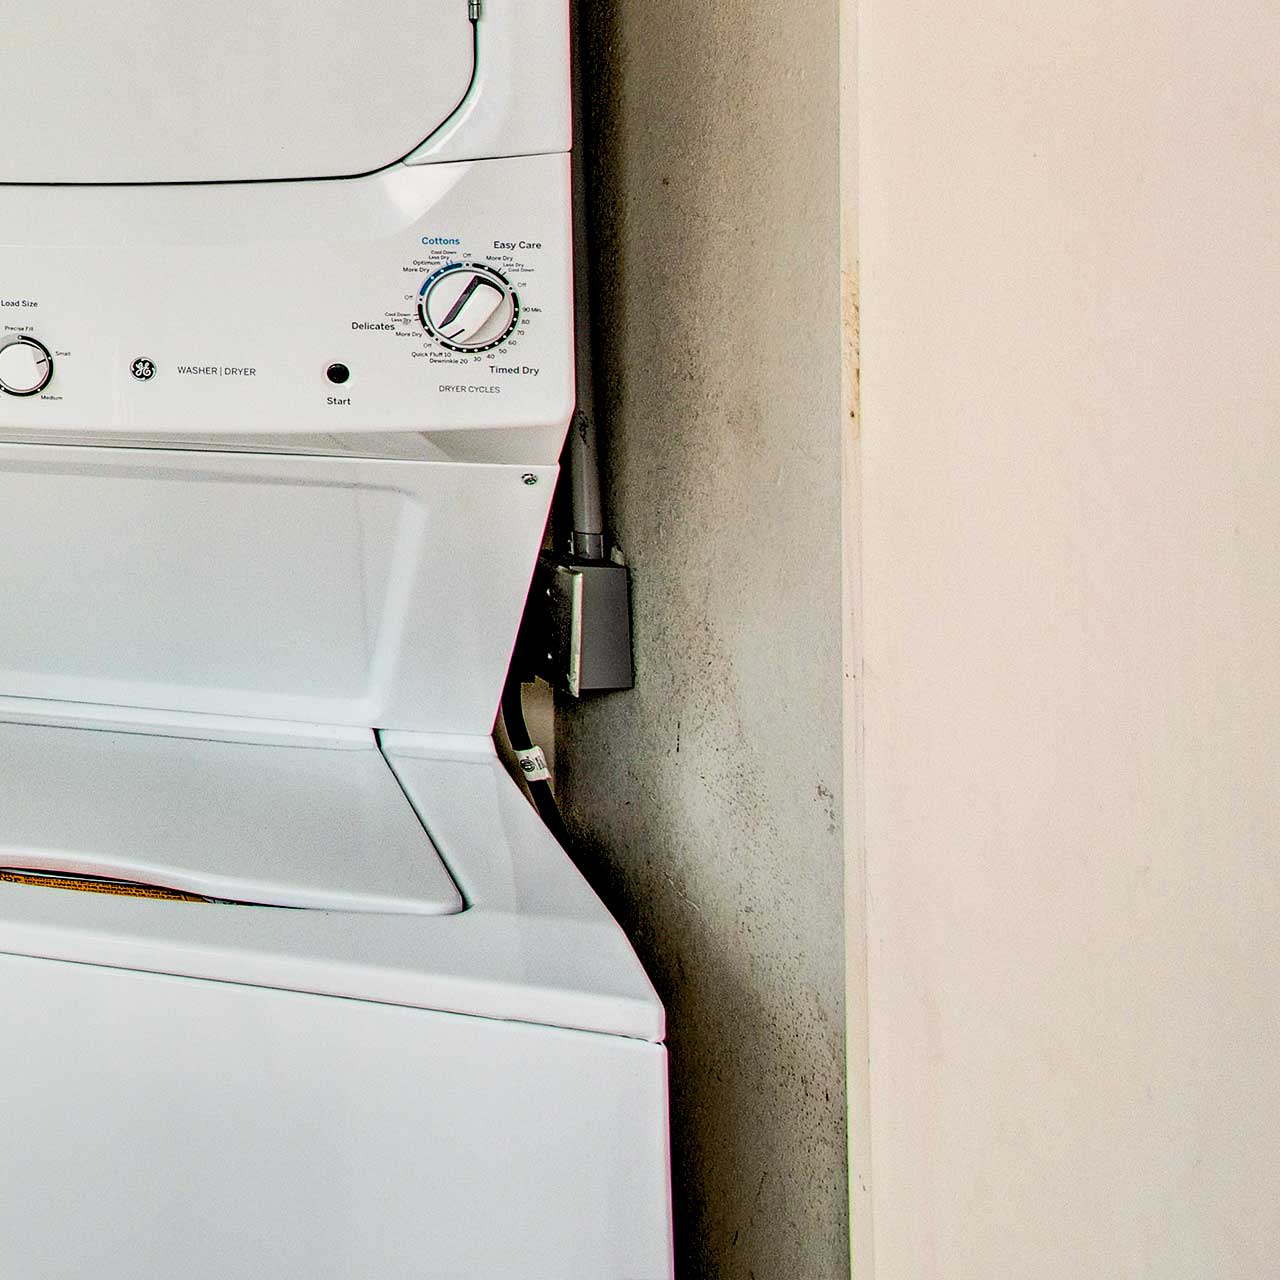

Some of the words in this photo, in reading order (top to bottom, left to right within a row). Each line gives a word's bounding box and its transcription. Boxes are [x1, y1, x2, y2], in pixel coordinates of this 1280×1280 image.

[421, 237, 461, 245] Cottons
[494, 240, 516, 251] Easy
[518, 241, 542, 249] Care
[0, 300, 20, 308] Load
[21, 300, 38, 308] Size
[351, 322, 395, 331] Delicates
[177, 366, 217, 375] WASHER
[224, 367, 256, 376] DRYER
[489, 365, 520, 374] Timed
[522, 366, 540, 376] Dry
[438, 385, 467, 393] DRYER
[468, 385, 501, 394] CYCLES
[327, 397, 351, 406] Start
